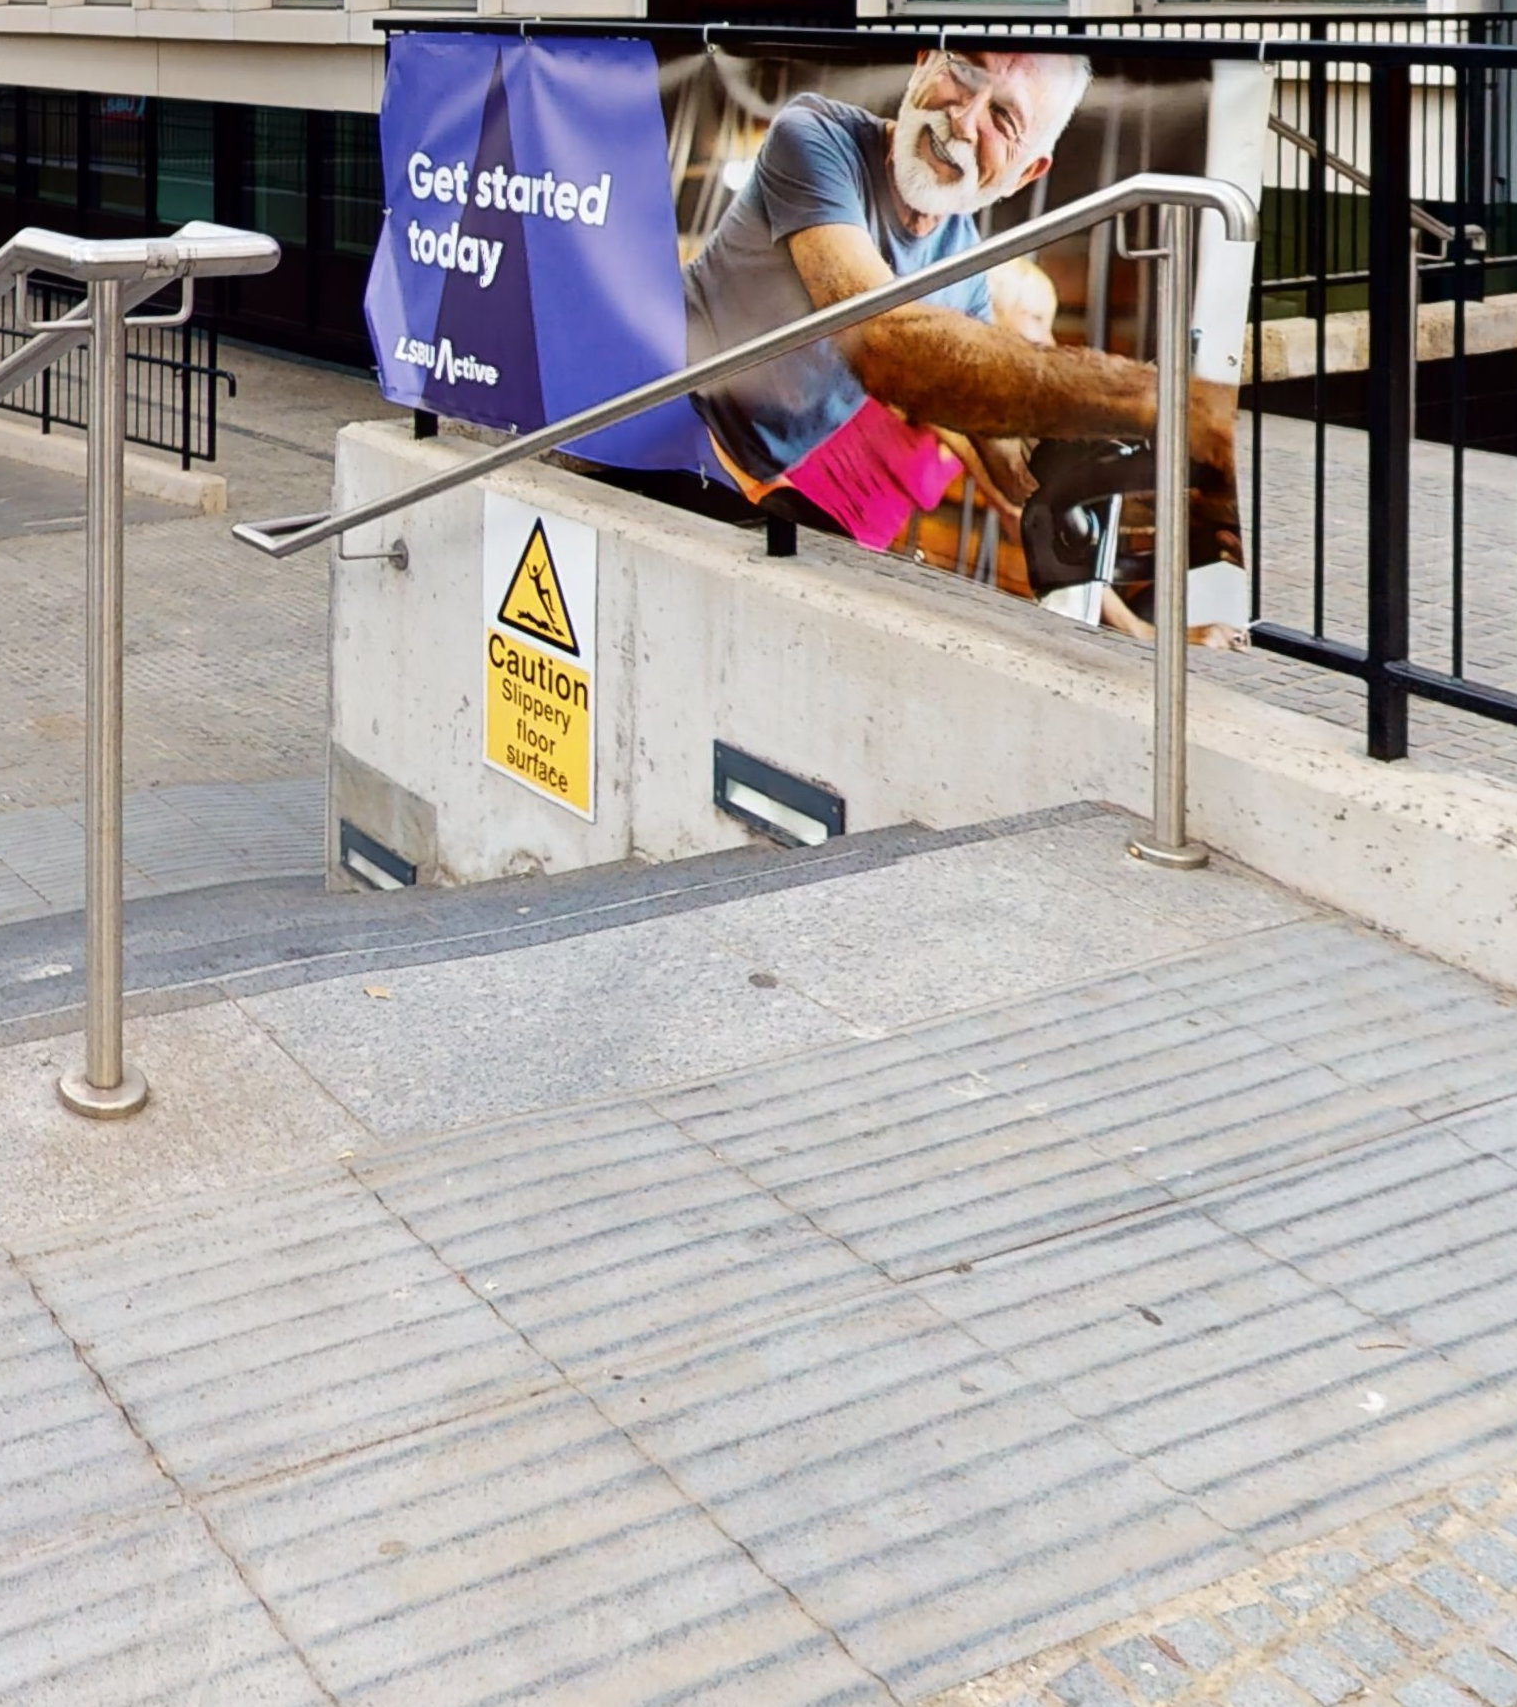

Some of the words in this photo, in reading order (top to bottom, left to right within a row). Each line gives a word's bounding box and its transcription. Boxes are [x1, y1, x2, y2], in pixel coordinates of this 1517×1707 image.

[407, 151, 469, 204] Get
[474, 165, 611, 225] started
[407, 219, 503, 288] today
[488, 633, 589, 712] Caution
[501, 677, 571, 735] Slippery
[516, 718, 557, 757] floor
[506, 744, 569, 793] surface
